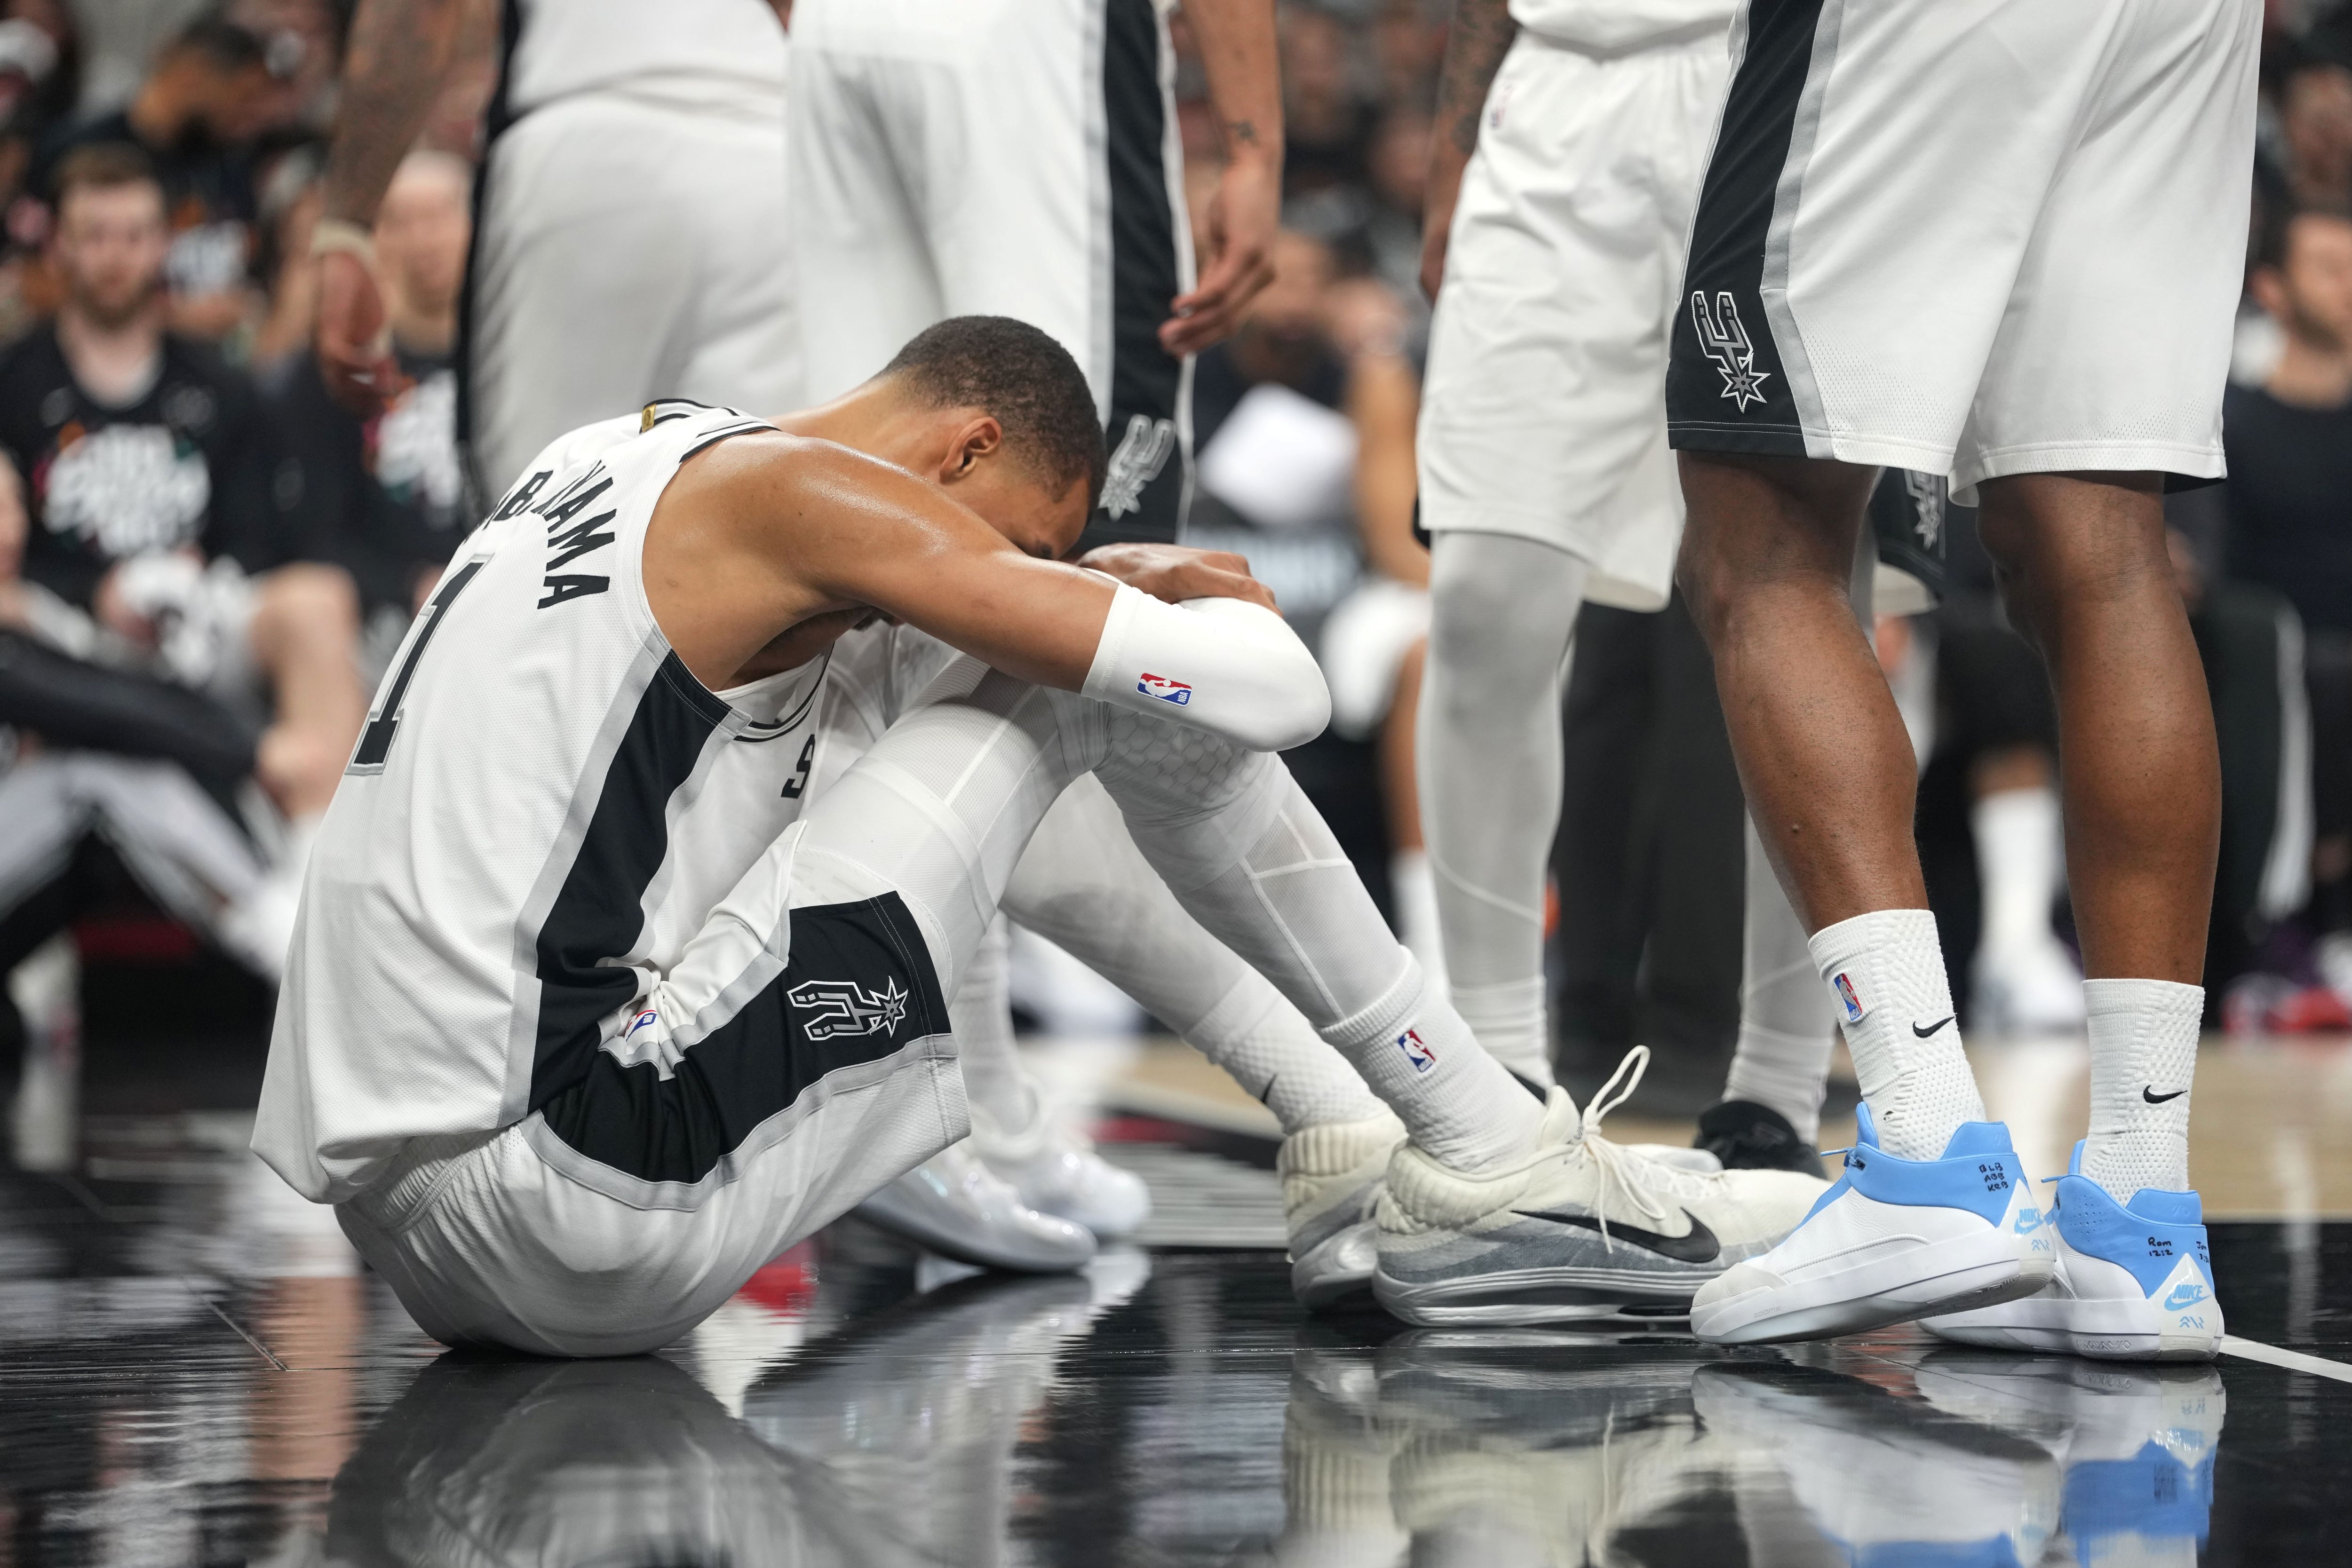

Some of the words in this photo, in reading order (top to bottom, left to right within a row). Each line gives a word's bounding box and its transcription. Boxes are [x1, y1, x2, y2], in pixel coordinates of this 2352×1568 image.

[344, 553, 495, 776] 1
[1177, 692, 1188, 703] NBA
[1850, 1007, 1860, 1018] NBA
[643, 1014, 653, 1023] NBA
[1979, 1162, 2003, 1173] BLB
[1984, 1172, 2005, 1182] ABB
[2148, 1236, 2172, 1247] Rom
[2172, 1284, 2203, 1299] NIKE
